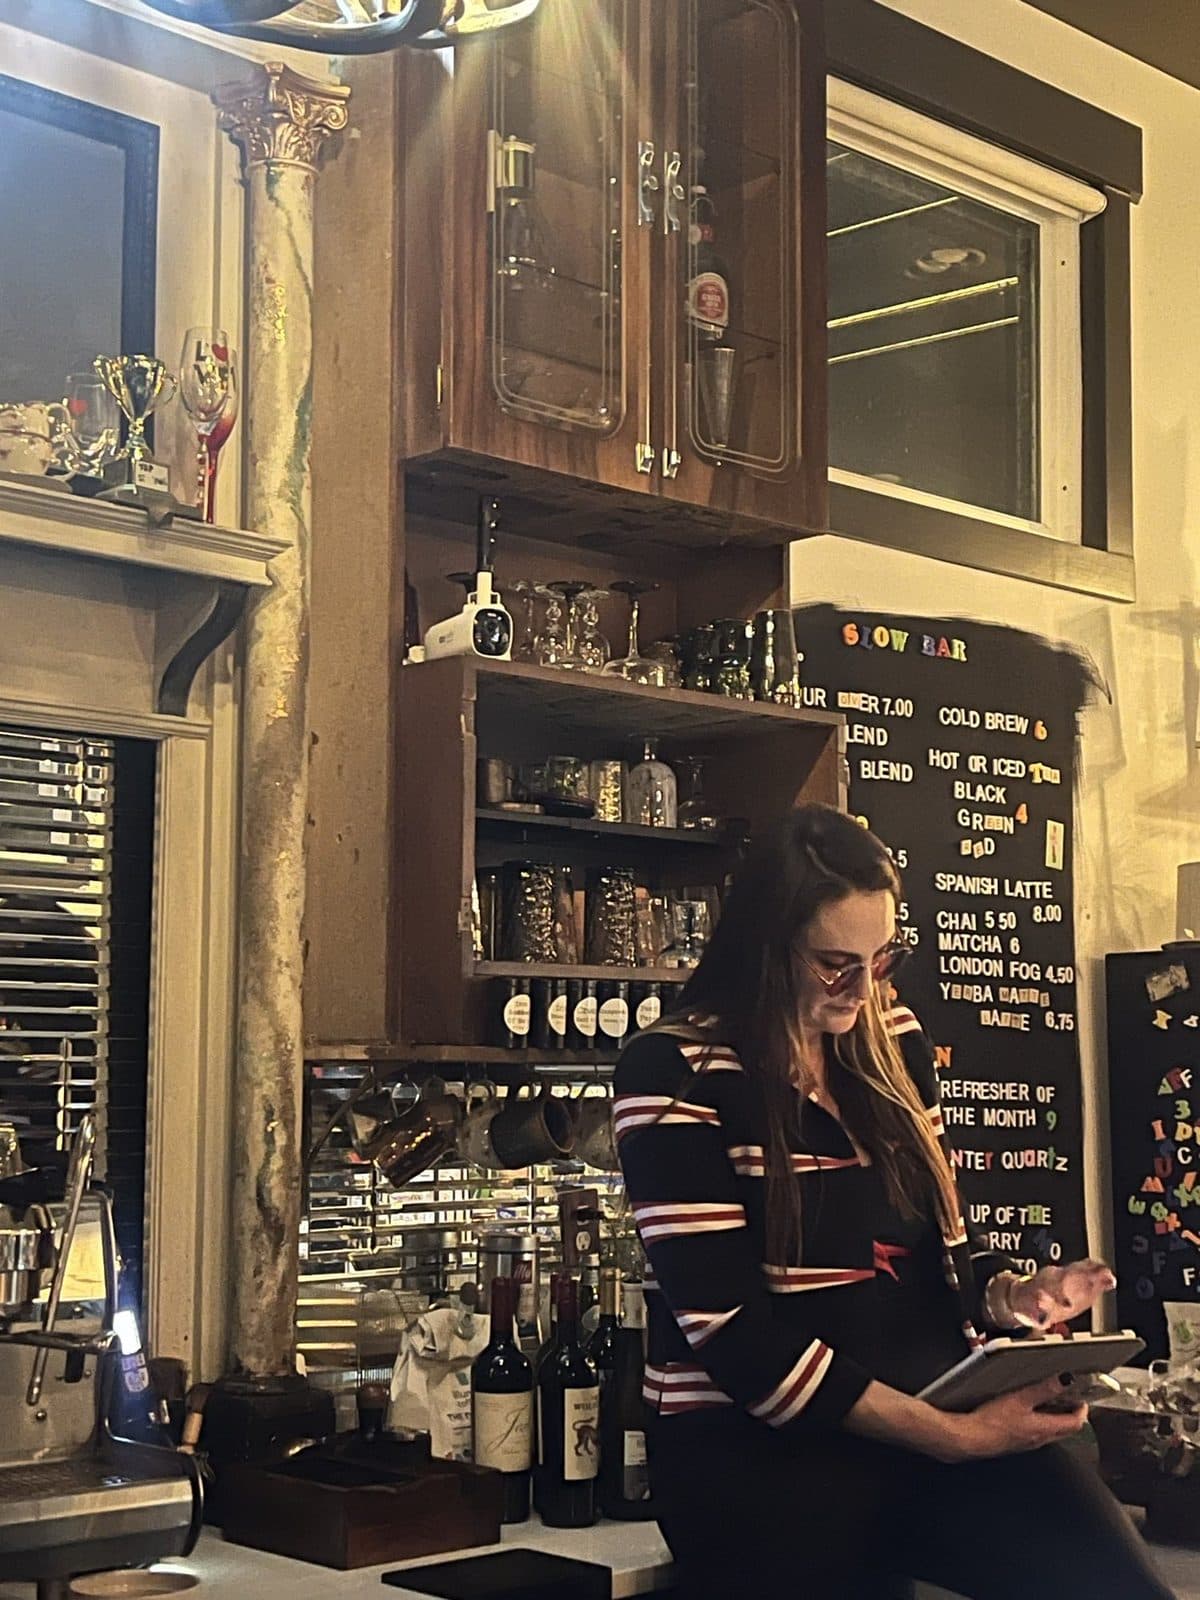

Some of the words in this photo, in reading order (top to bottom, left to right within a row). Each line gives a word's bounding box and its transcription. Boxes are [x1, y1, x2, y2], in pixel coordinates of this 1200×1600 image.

[842, 622, 909, 653] SLOW
[921, 634, 968, 662] BAR
[803, 687, 828, 708] UR
[883, 698, 914, 718] 7.00
[846, 724, 888, 746] LEND
[939, 707, 981, 729] COLD
[985, 711, 1029, 735] BREW
[1033, 720, 1048, 740] 6
[860, 760, 914, 784] BLEND
[928, 749, 960, 771] HOT
[968, 754, 989, 774] OR
[992, 757, 1026, 779] ICED
[954, 781, 1007, 804] BLACK
[957, 808, 1014, 835] GREEN
[1015, 803, 1029, 824] 4
[935, 873, 999, 896] SPANISH
[1004, 879, 1053, 900] LATTE
[936, 910, 977, 932] CHAI
[1033, 905, 1063, 923] 8.00
[938, 933, 1003, 954] MATCHA
[1009, 937, 1021, 955] 6
[939, 956, 1004, 978] LONDON
[1009, 960, 1042, 982] FOG
[1044, 964, 1074, 985] 4.50
[1044, 1011, 1074, 1032] 6.75
[934, 1046, 953, 1068] N
[940, 1079, 1031, 1103] REFRESHER
[1036, 1084, 1056, 1104] OF
[943, 1107, 976, 1126] THE
[983, 1108, 1037, 1129] MONTH
[1045, 1110, 1058, 1131] 9
[969, 1203, 991, 1224] UP
[995, 1206, 1016, 1225] OF
[1017, 1205, 1052, 1226] THE
[988, 1231, 1023, 1251] RRY
